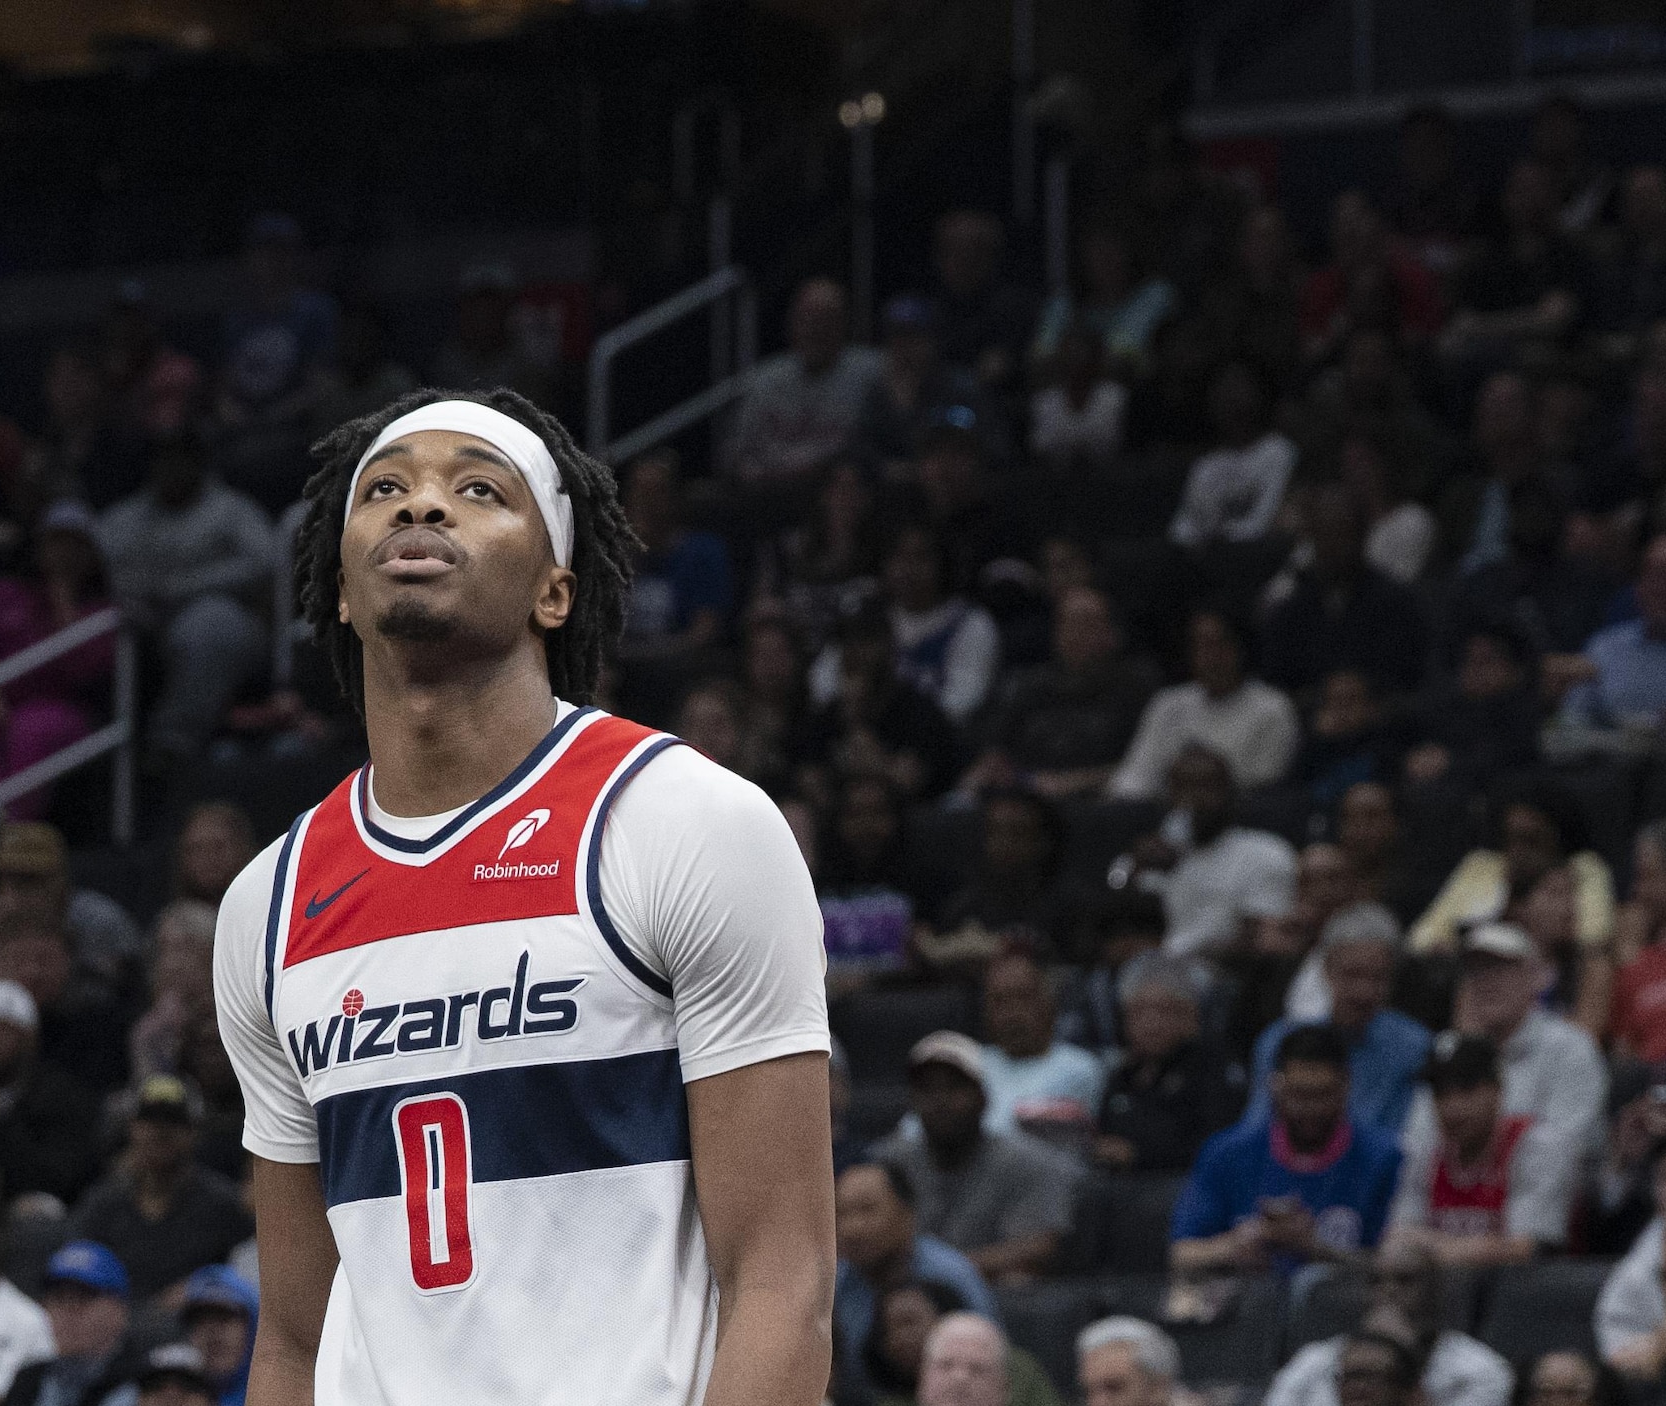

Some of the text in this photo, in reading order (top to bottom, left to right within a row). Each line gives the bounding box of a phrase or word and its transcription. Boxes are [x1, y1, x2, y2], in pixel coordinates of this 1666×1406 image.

[473, 859, 560, 881] Robinhood
[288, 949, 587, 1079] wizards
[393, 1091, 479, 1296] 0
